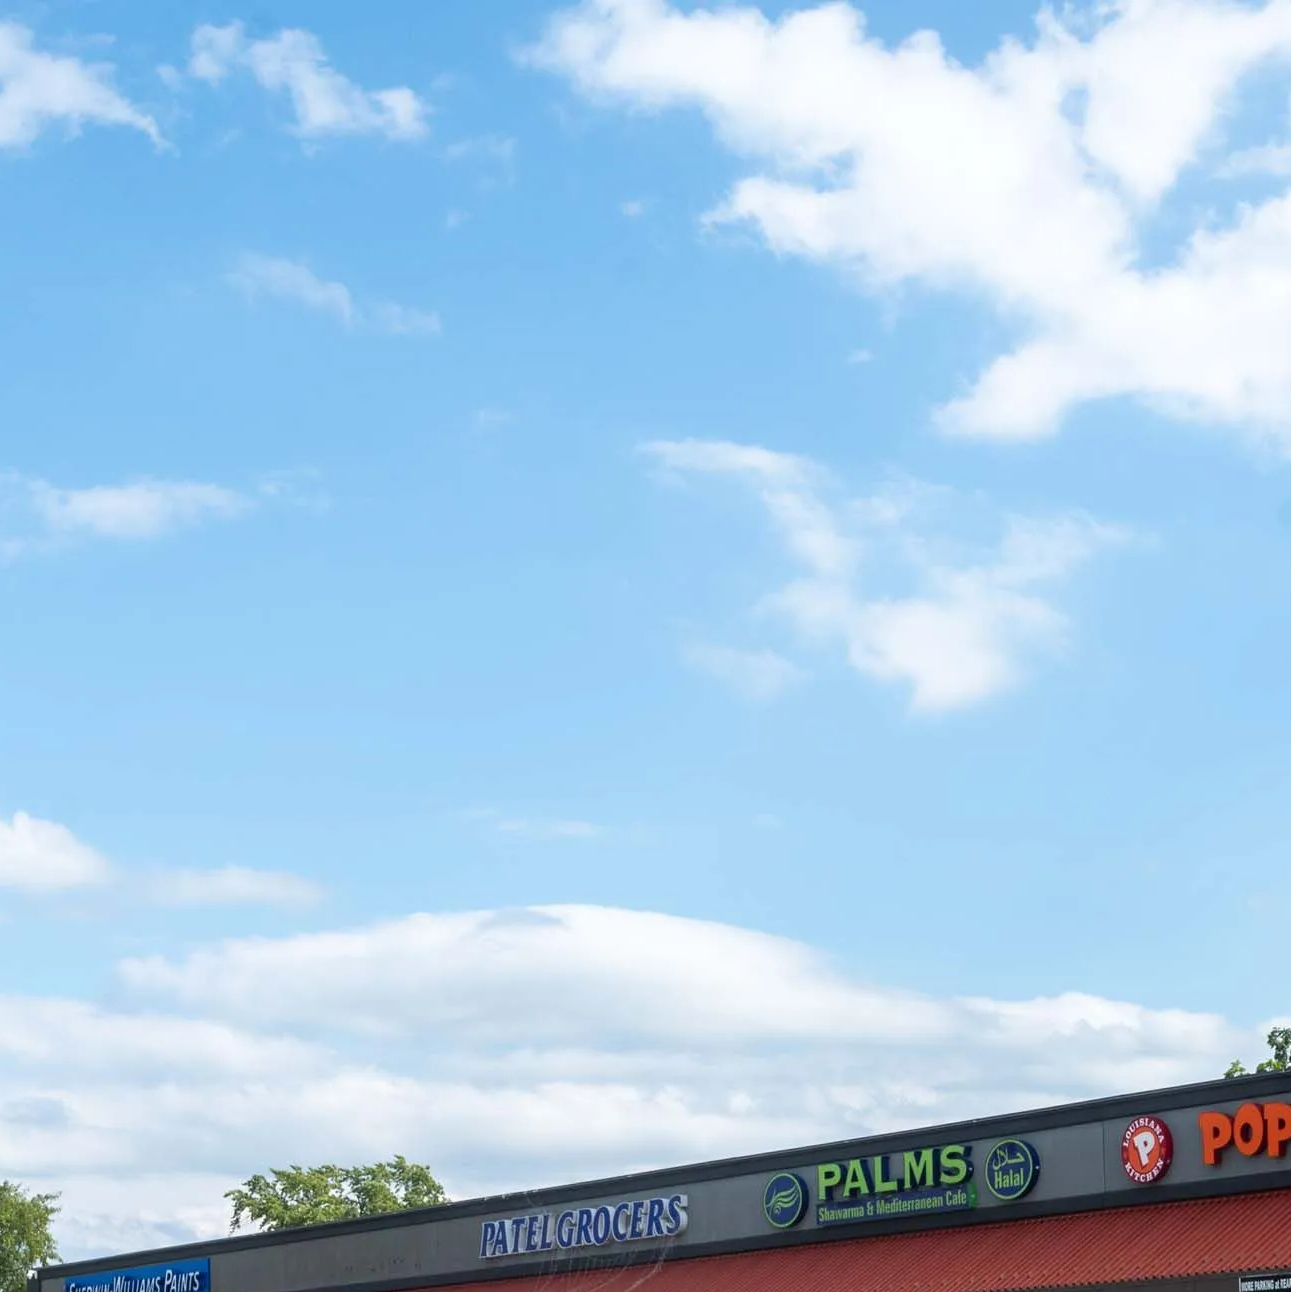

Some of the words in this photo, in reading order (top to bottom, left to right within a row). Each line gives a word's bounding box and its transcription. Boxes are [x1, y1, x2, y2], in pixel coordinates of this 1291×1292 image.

[1123, 1117, 1165, 1148] LOUISIANA
[817, 1144, 969, 1201] PALMS
[994, 1168, 1025, 1190] Halal
[1125, 1158, 1164, 1182] KITCHEN
[818, 1203, 865, 1222] Shawarma
[866, 1202, 874, 1216] &
[876, 1193, 944, 1215] Mediterranean
[945, 1191, 967, 1207] Cafe
[479, 1213, 553, 1259] PATEL
[556, 1194, 686, 1249] GROCERS
[1241, 1281, 1254, 1292] MORE
[1254, 1279, 1275, 1292] PARKING
